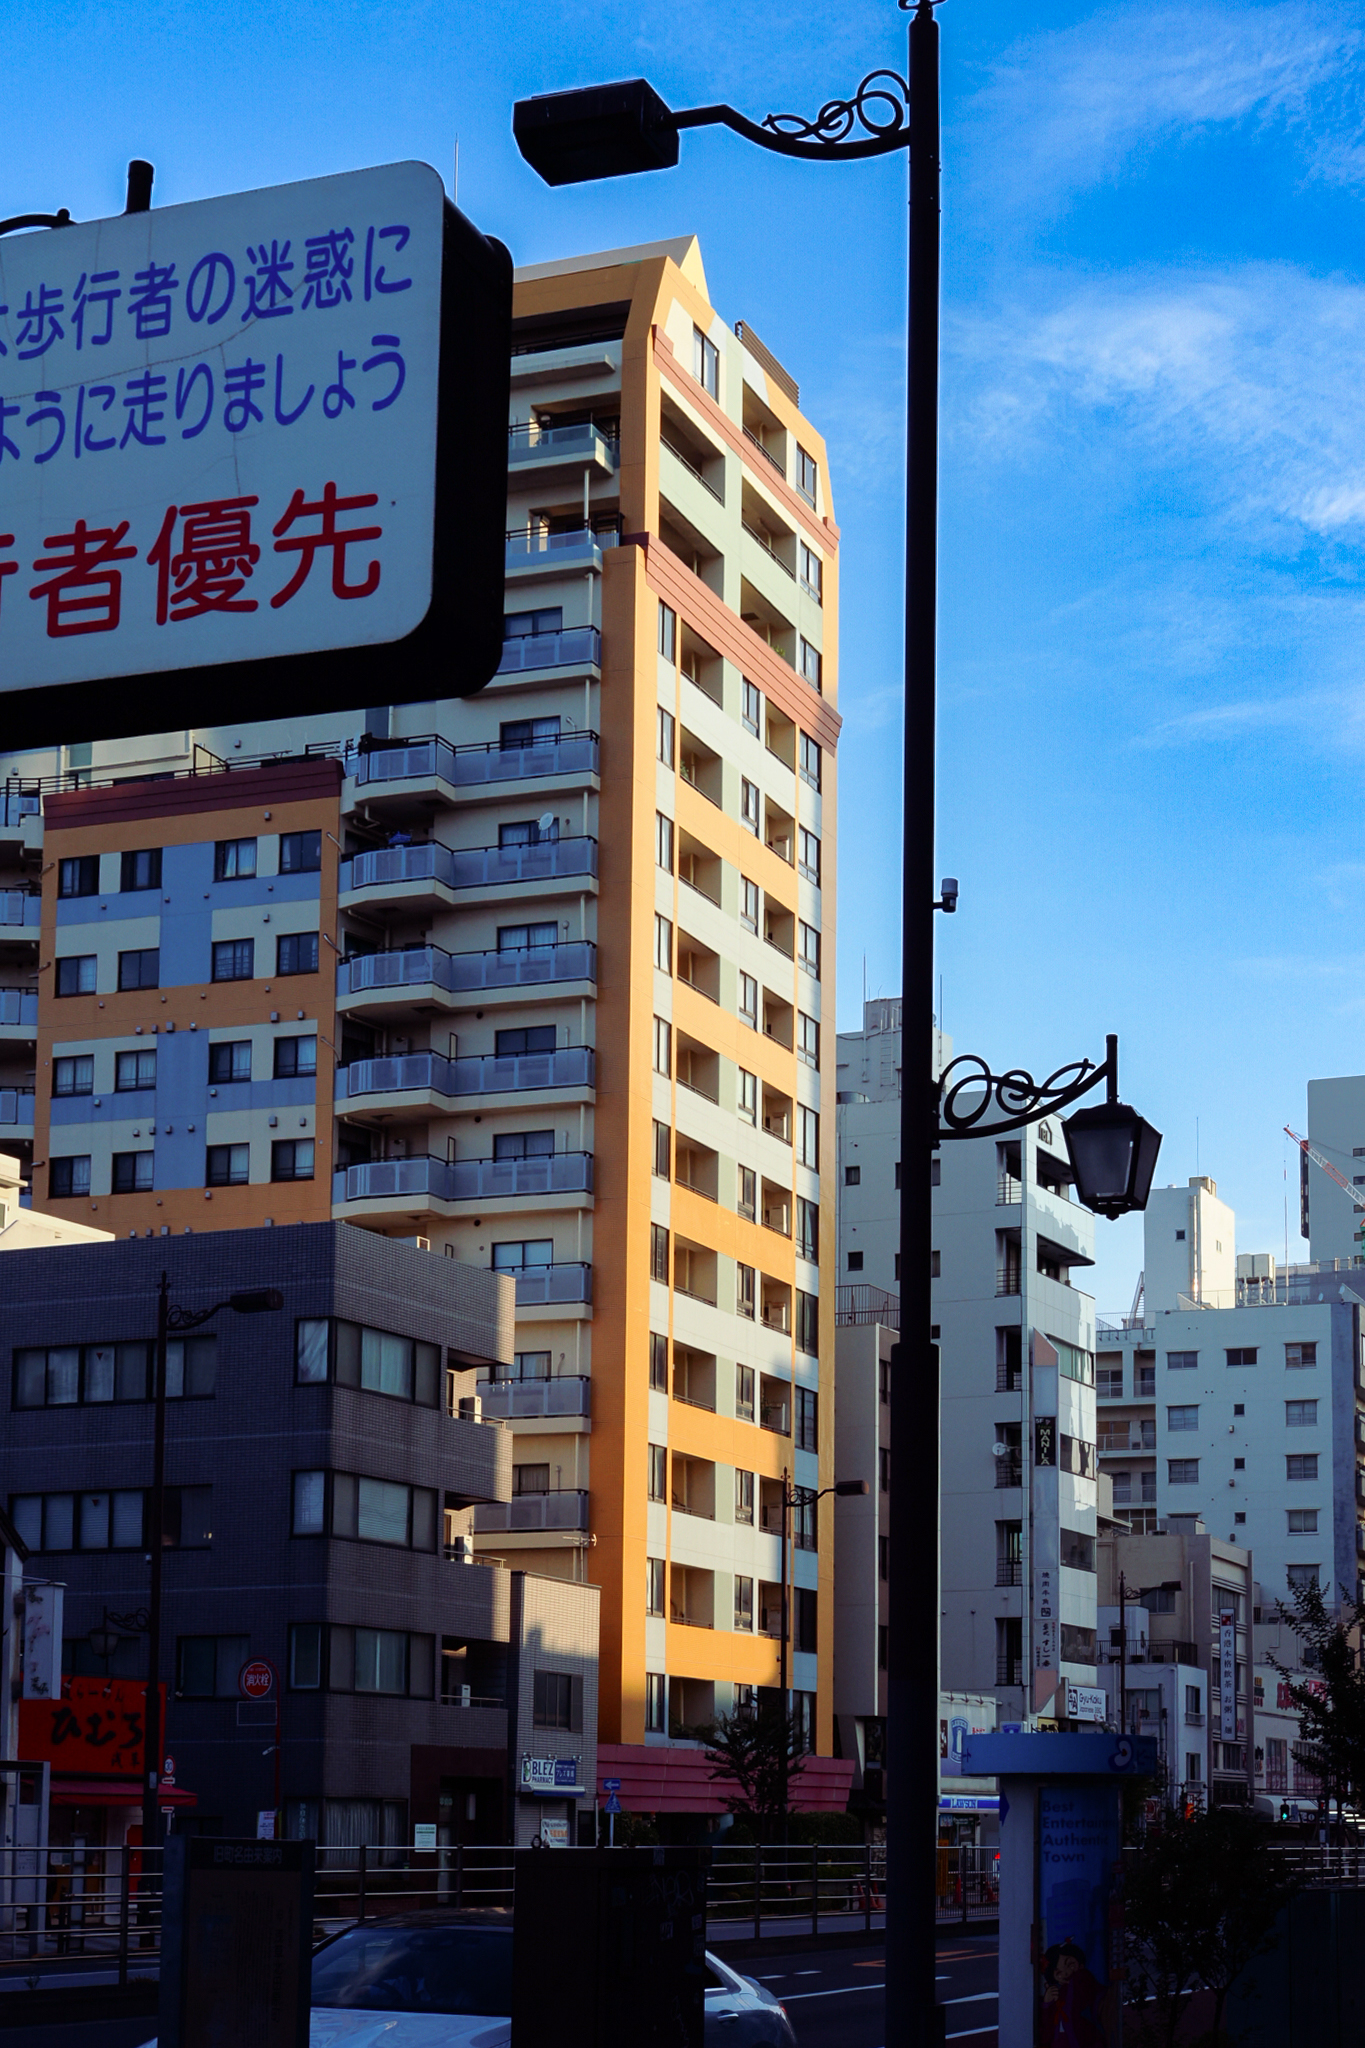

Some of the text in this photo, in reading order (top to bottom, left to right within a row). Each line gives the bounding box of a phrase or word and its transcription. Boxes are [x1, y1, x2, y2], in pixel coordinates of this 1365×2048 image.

[0, 226, 412, 360] 歩行者の迷惑に
[0, 481, 382, 638] 者優先
[1040, 1428, 1050, 1466] MANILA
[1223, 1629, 1232, 1688] 香港本格飲茶
[246, 1673, 270, 1687] 消火栓
[51, 1706, 143, 1749] ひむろ
[165, 1761, 173, 1771] 30
[532, 1761, 554, 1776] BLEZ
[532, 1776, 554, 1784] PHARMACY
[951, 1798, 977, 1808] LAWSON
[1042, 1800, 1074, 1812] Best
[213, 1844, 283, 1864] 旧町名由来案内
[1043, 1851, 1085, 1863] Town
